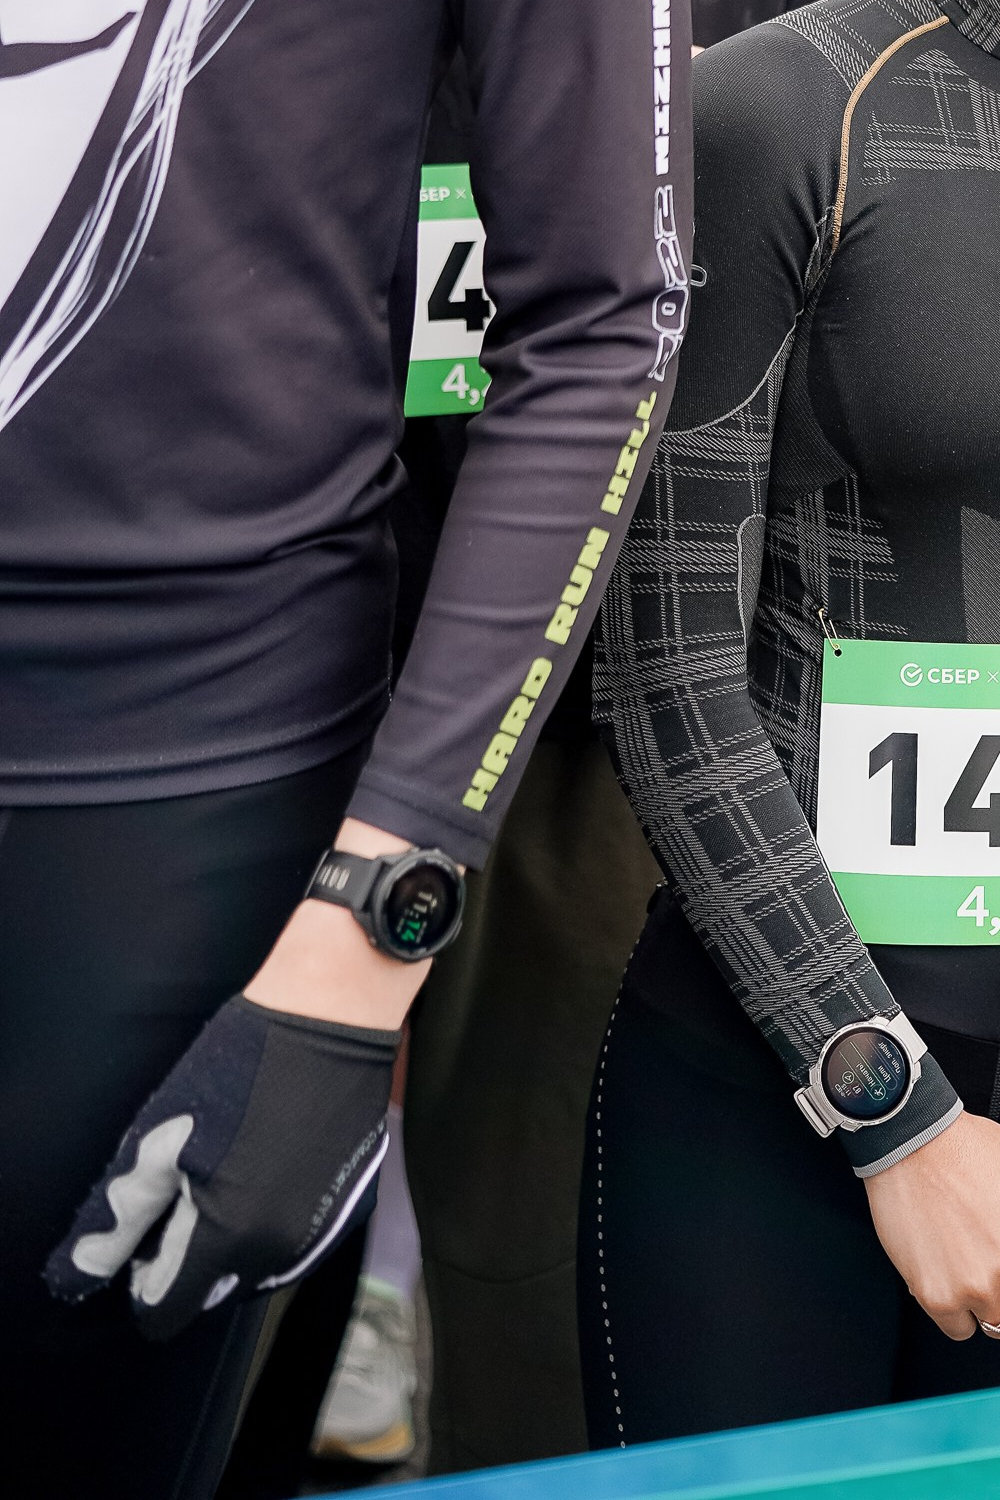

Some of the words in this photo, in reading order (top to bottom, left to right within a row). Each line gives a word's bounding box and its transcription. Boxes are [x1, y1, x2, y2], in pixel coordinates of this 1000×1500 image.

[647, 185, 689, 381] 2022
[441, 363, 492, 406] 4,
[463, 657, 552, 812] HARD
[545, 527, 610, 646] RUN
[601, 391, 657, 515] HILL
[927, 668, 980, 684] СБЕР
[856, 1063, 876, 1087] Начать!
[878, 1065, 892, 1084] Цели
